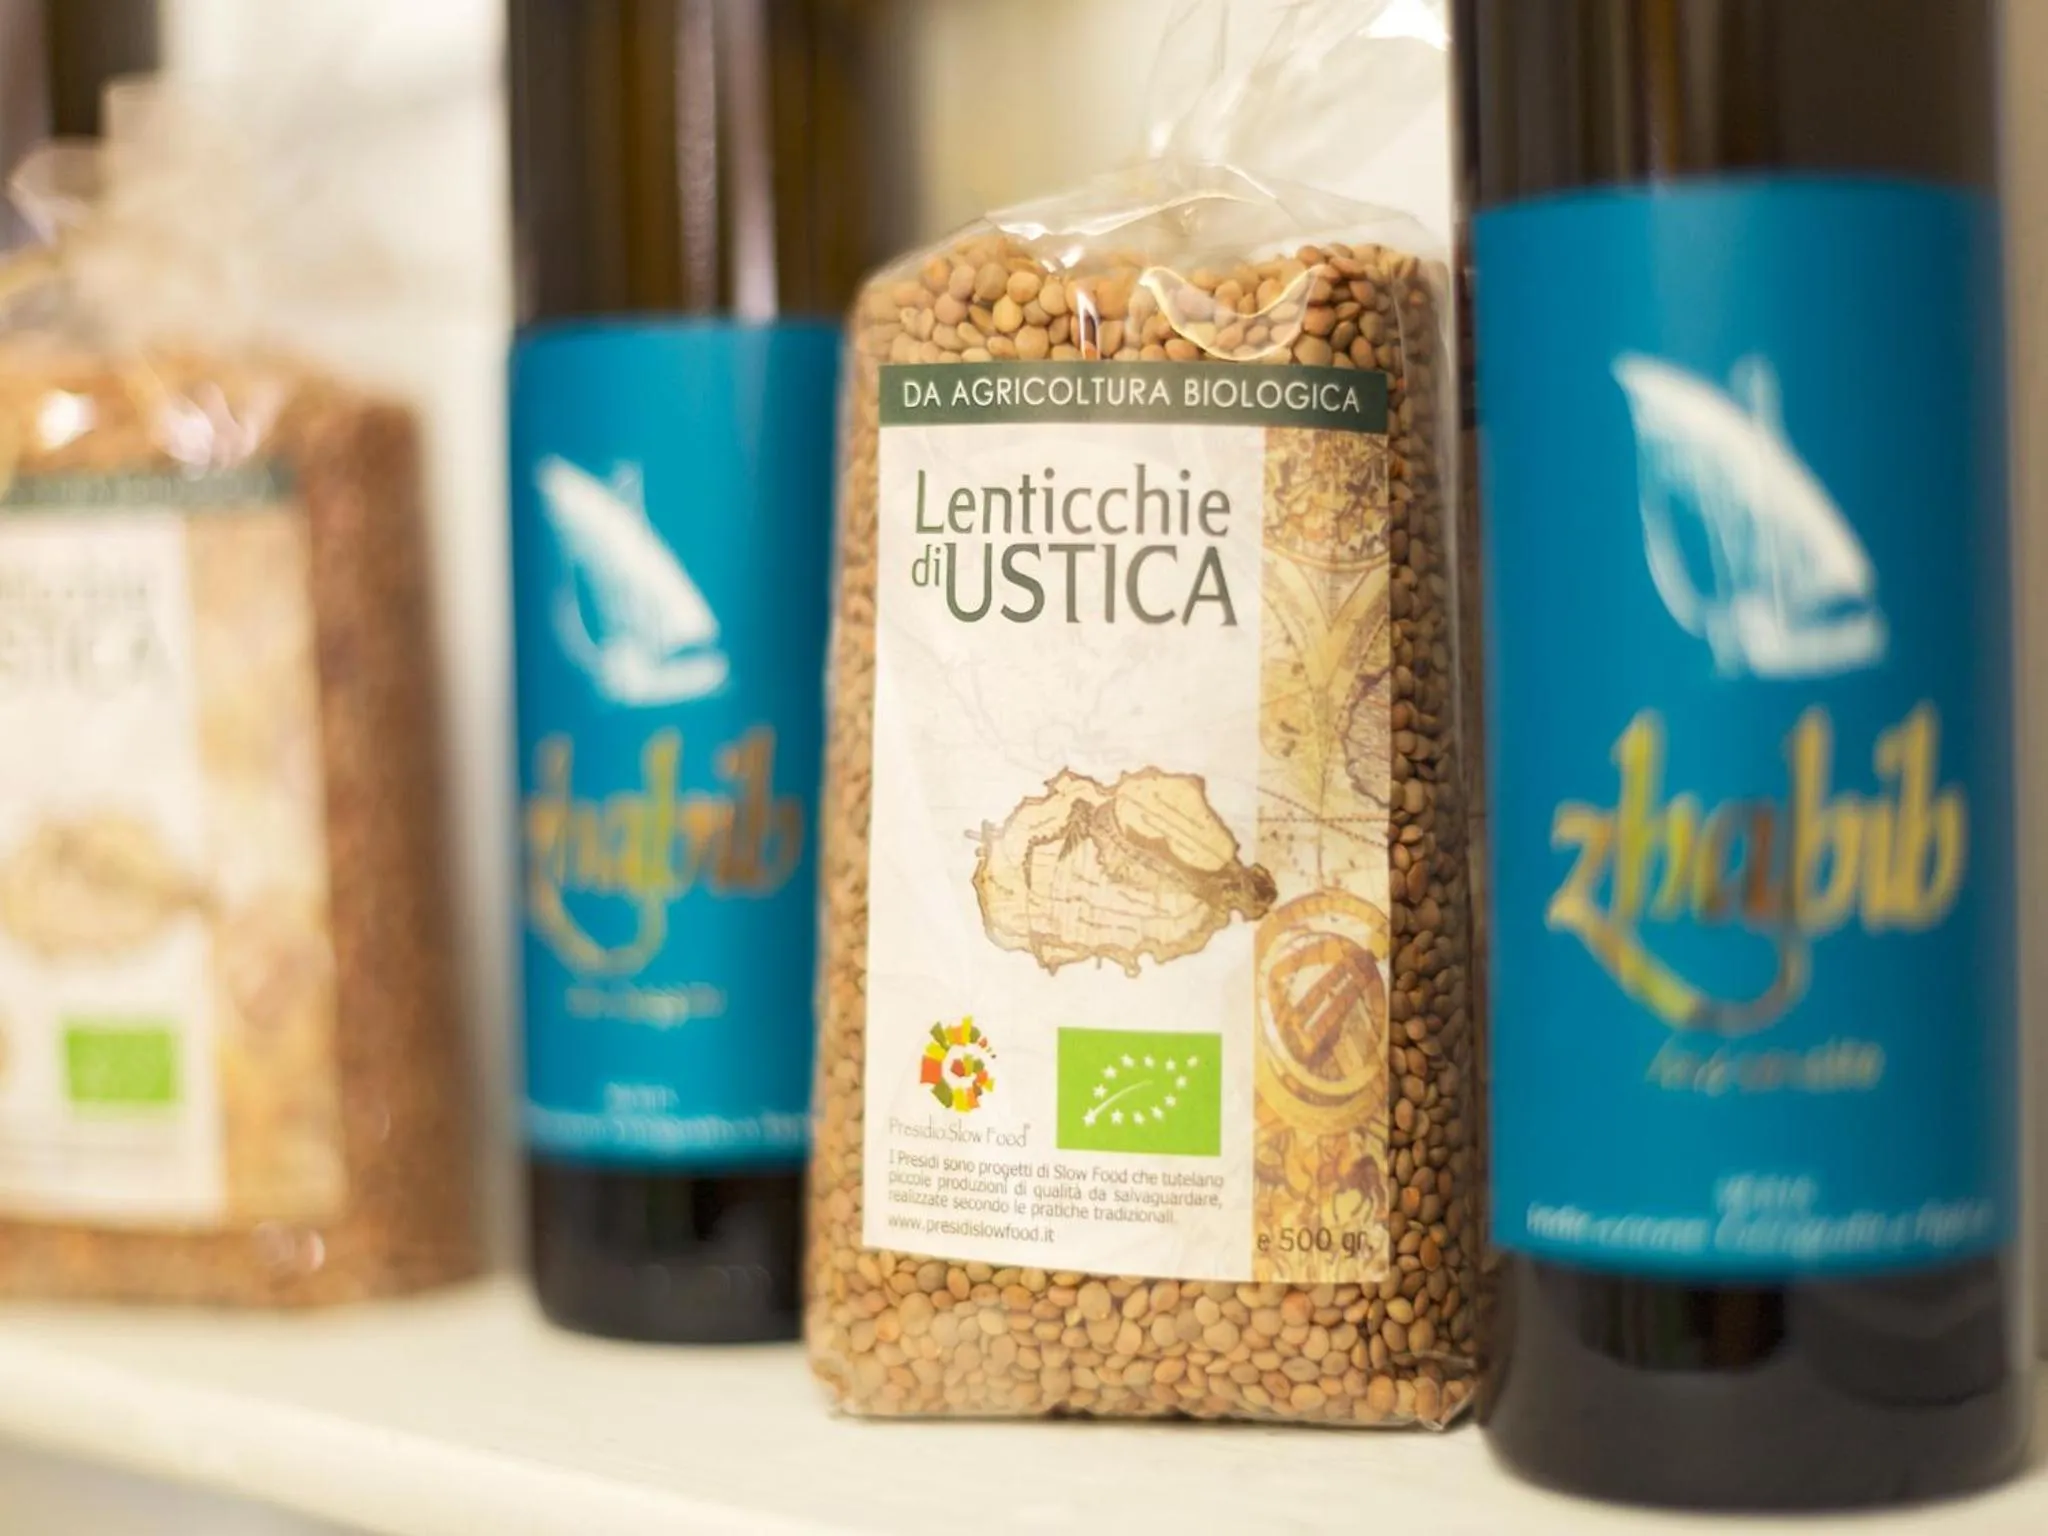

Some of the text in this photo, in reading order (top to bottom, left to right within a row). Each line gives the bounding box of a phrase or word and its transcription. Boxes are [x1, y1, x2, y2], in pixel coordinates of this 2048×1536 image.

[903, 376, 1360, 413] DA AGRICOLTURA BIOLOGICA
[914, 463, 1231, 538] Lenticchie
[911, 542, 1239, 627] di USTICA
[1546, 700, 1967, 1037] zhabib
[889, 1148, 1225, 1189] I Presidi sono progetti di Slow Food che tutelano
[888, 1169, 1223, 1210] piccole produzioni di qualità da salvaguardare,
[888, 1187, 1178, 1225] realizzate secondo le pratiche tradizionali.
[888, 1213, 1056, 1243] www.presidislowfood.it
[1279, 1226, 1332, 1252] 500
